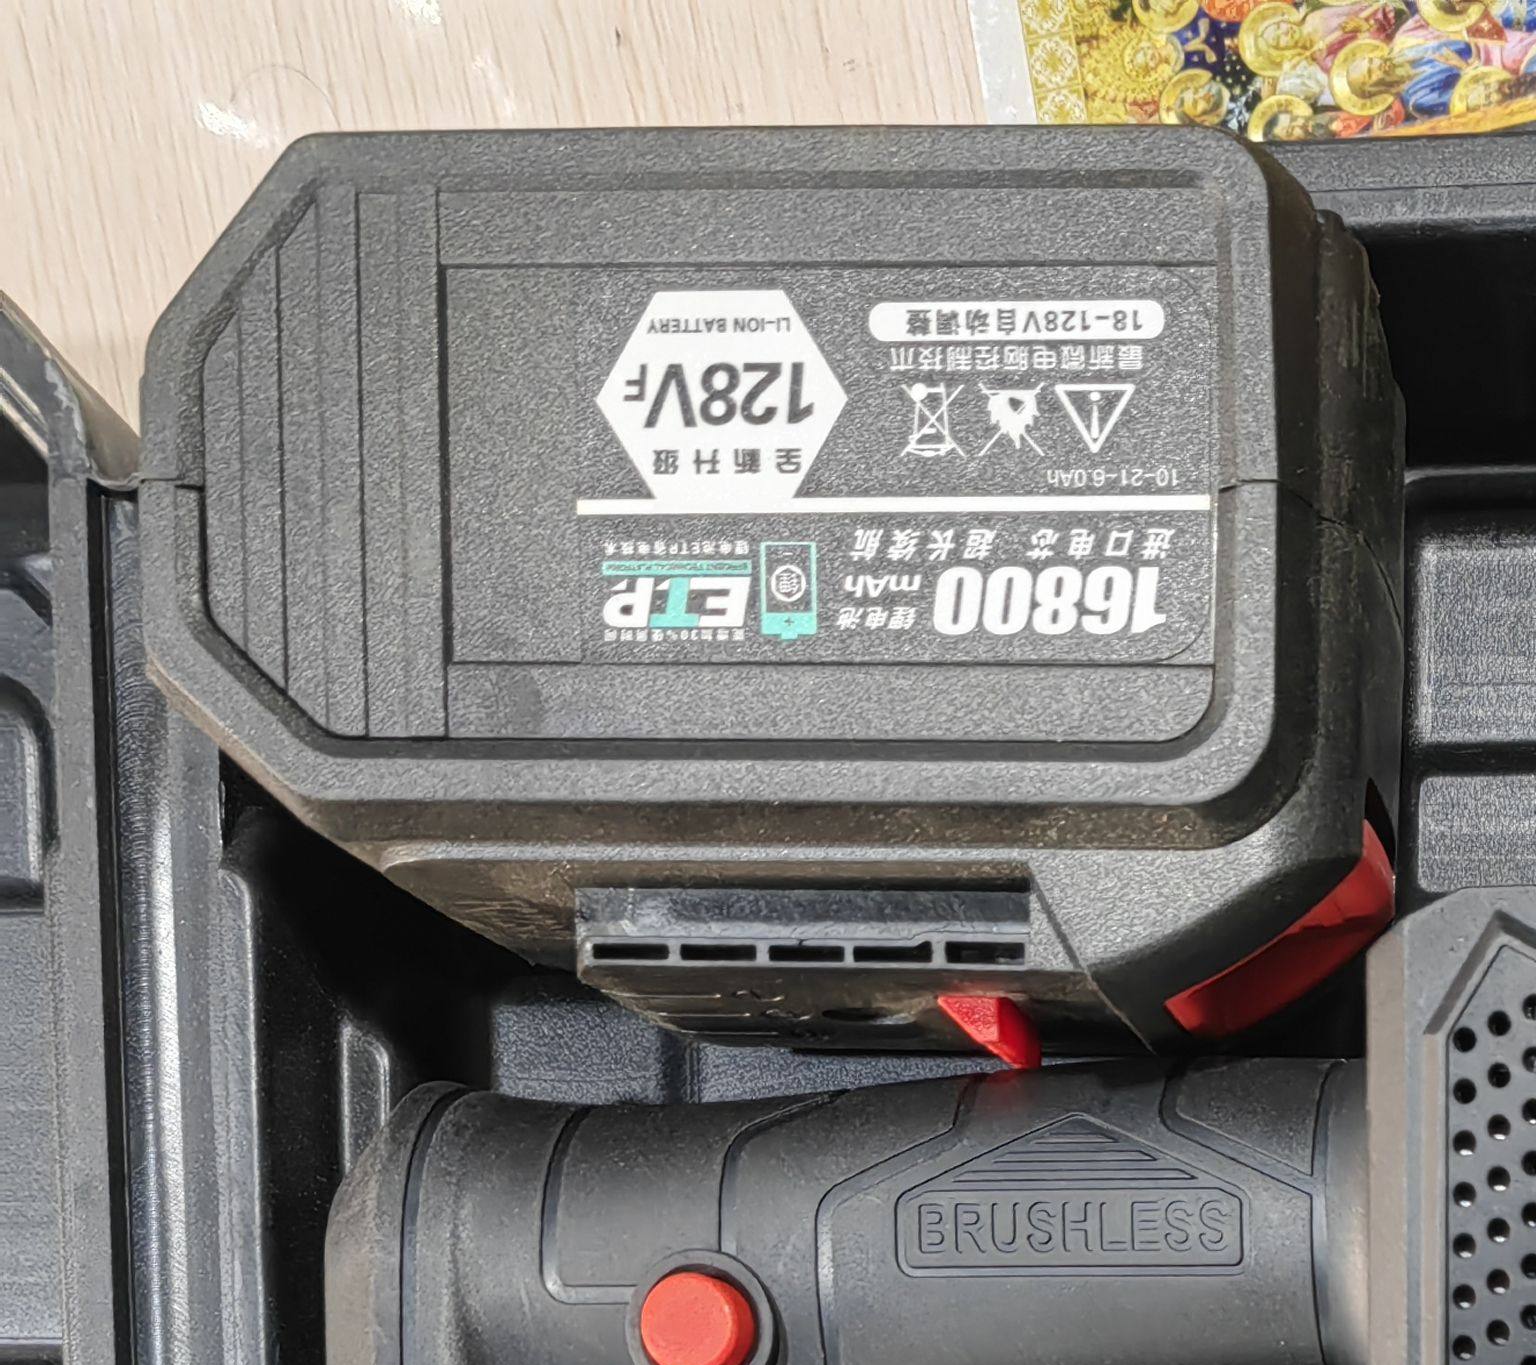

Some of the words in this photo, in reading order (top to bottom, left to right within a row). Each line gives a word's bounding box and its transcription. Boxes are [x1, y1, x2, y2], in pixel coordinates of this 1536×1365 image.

[647, 317, 727, 334] BATTERY
[732, 316, 790, 332] LI-ION
[890, 345, 1142, 370] 最新微电脑控制技术
[651, 447, 802, 475] 全新升级
[851, 528, 996, 560] 超长续航
[1026, 528, 1174, 559] 进口电芯
[844, 573, 920, 595] mAh
[602, 577, 752, 627] ETP
[934, 565, 1165, 635] 16800
[838, 607, 917, 631] 锂电池
[918, 1200, 1232, 1254] BRUSHLESS
